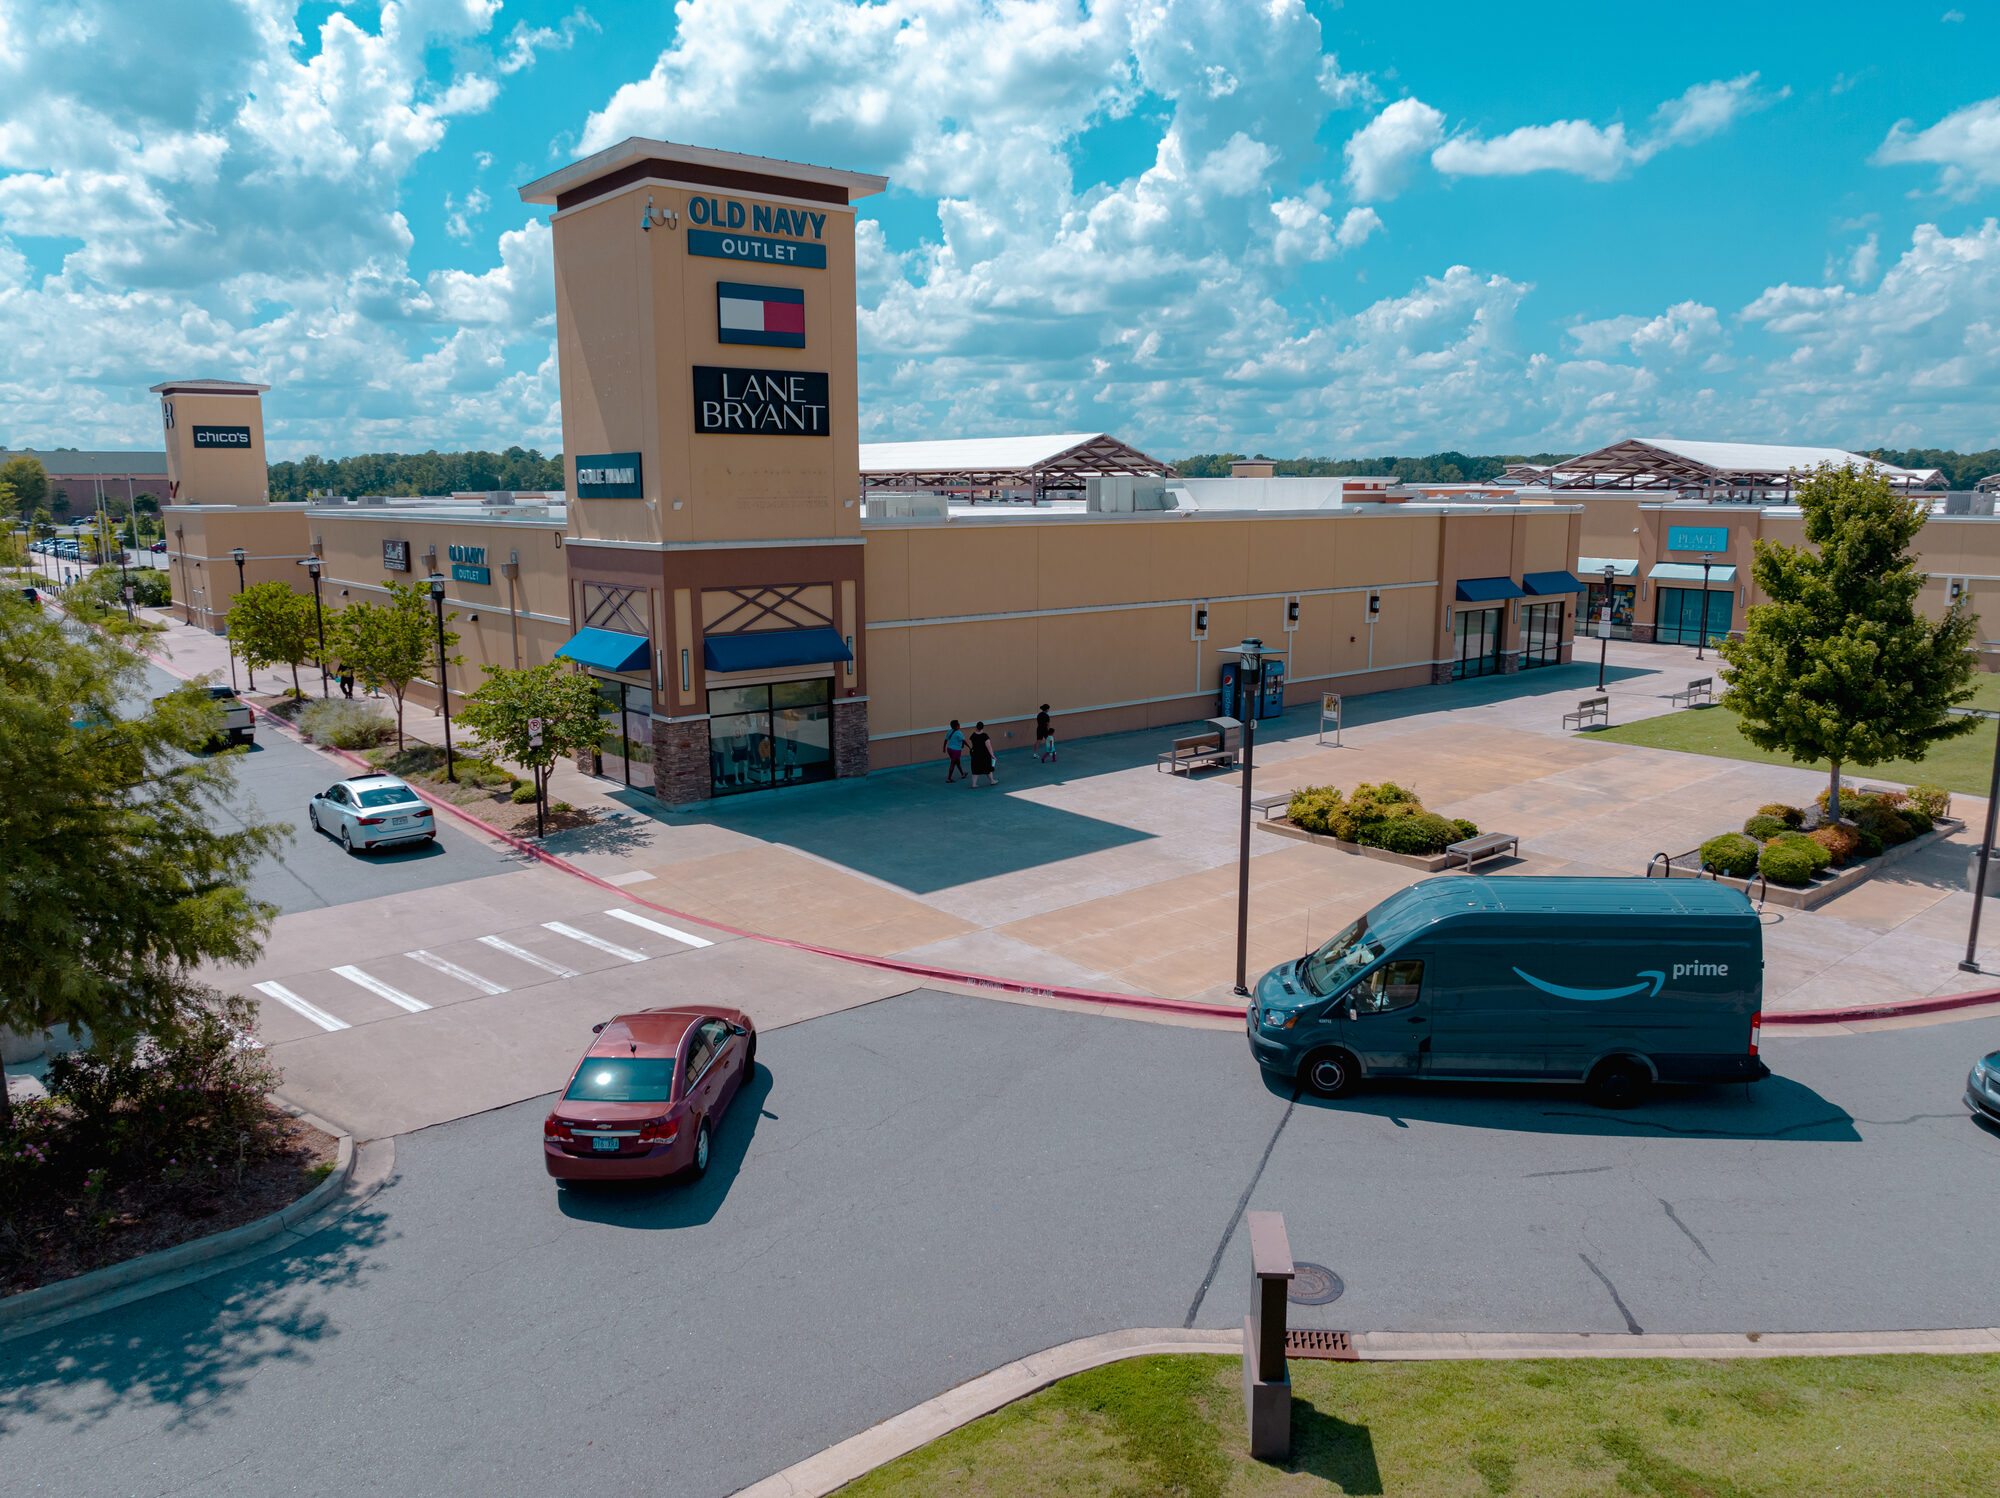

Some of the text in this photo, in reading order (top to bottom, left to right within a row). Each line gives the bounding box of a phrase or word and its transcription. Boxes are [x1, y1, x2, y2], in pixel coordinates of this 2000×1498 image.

[688, 196, 827, 239] OLD NAVY
[722, 239, 797, 260] OUTLET
[723, 373, 807, 402] LANE
[703, 401, 825, 430] BRYANT
[197, 432, 248, 442] chico's
[578, 468, 604, 484] COLE
[555, 532, 561, 549] D
[1678, 533, 1718, 545] PLACE
[449, 545, 464, 562] OLD
[459, 569, 479, 581] OUTLET
[1612, 595, 1629, 613] 75
[1673, 960, 1728, 979] prime
